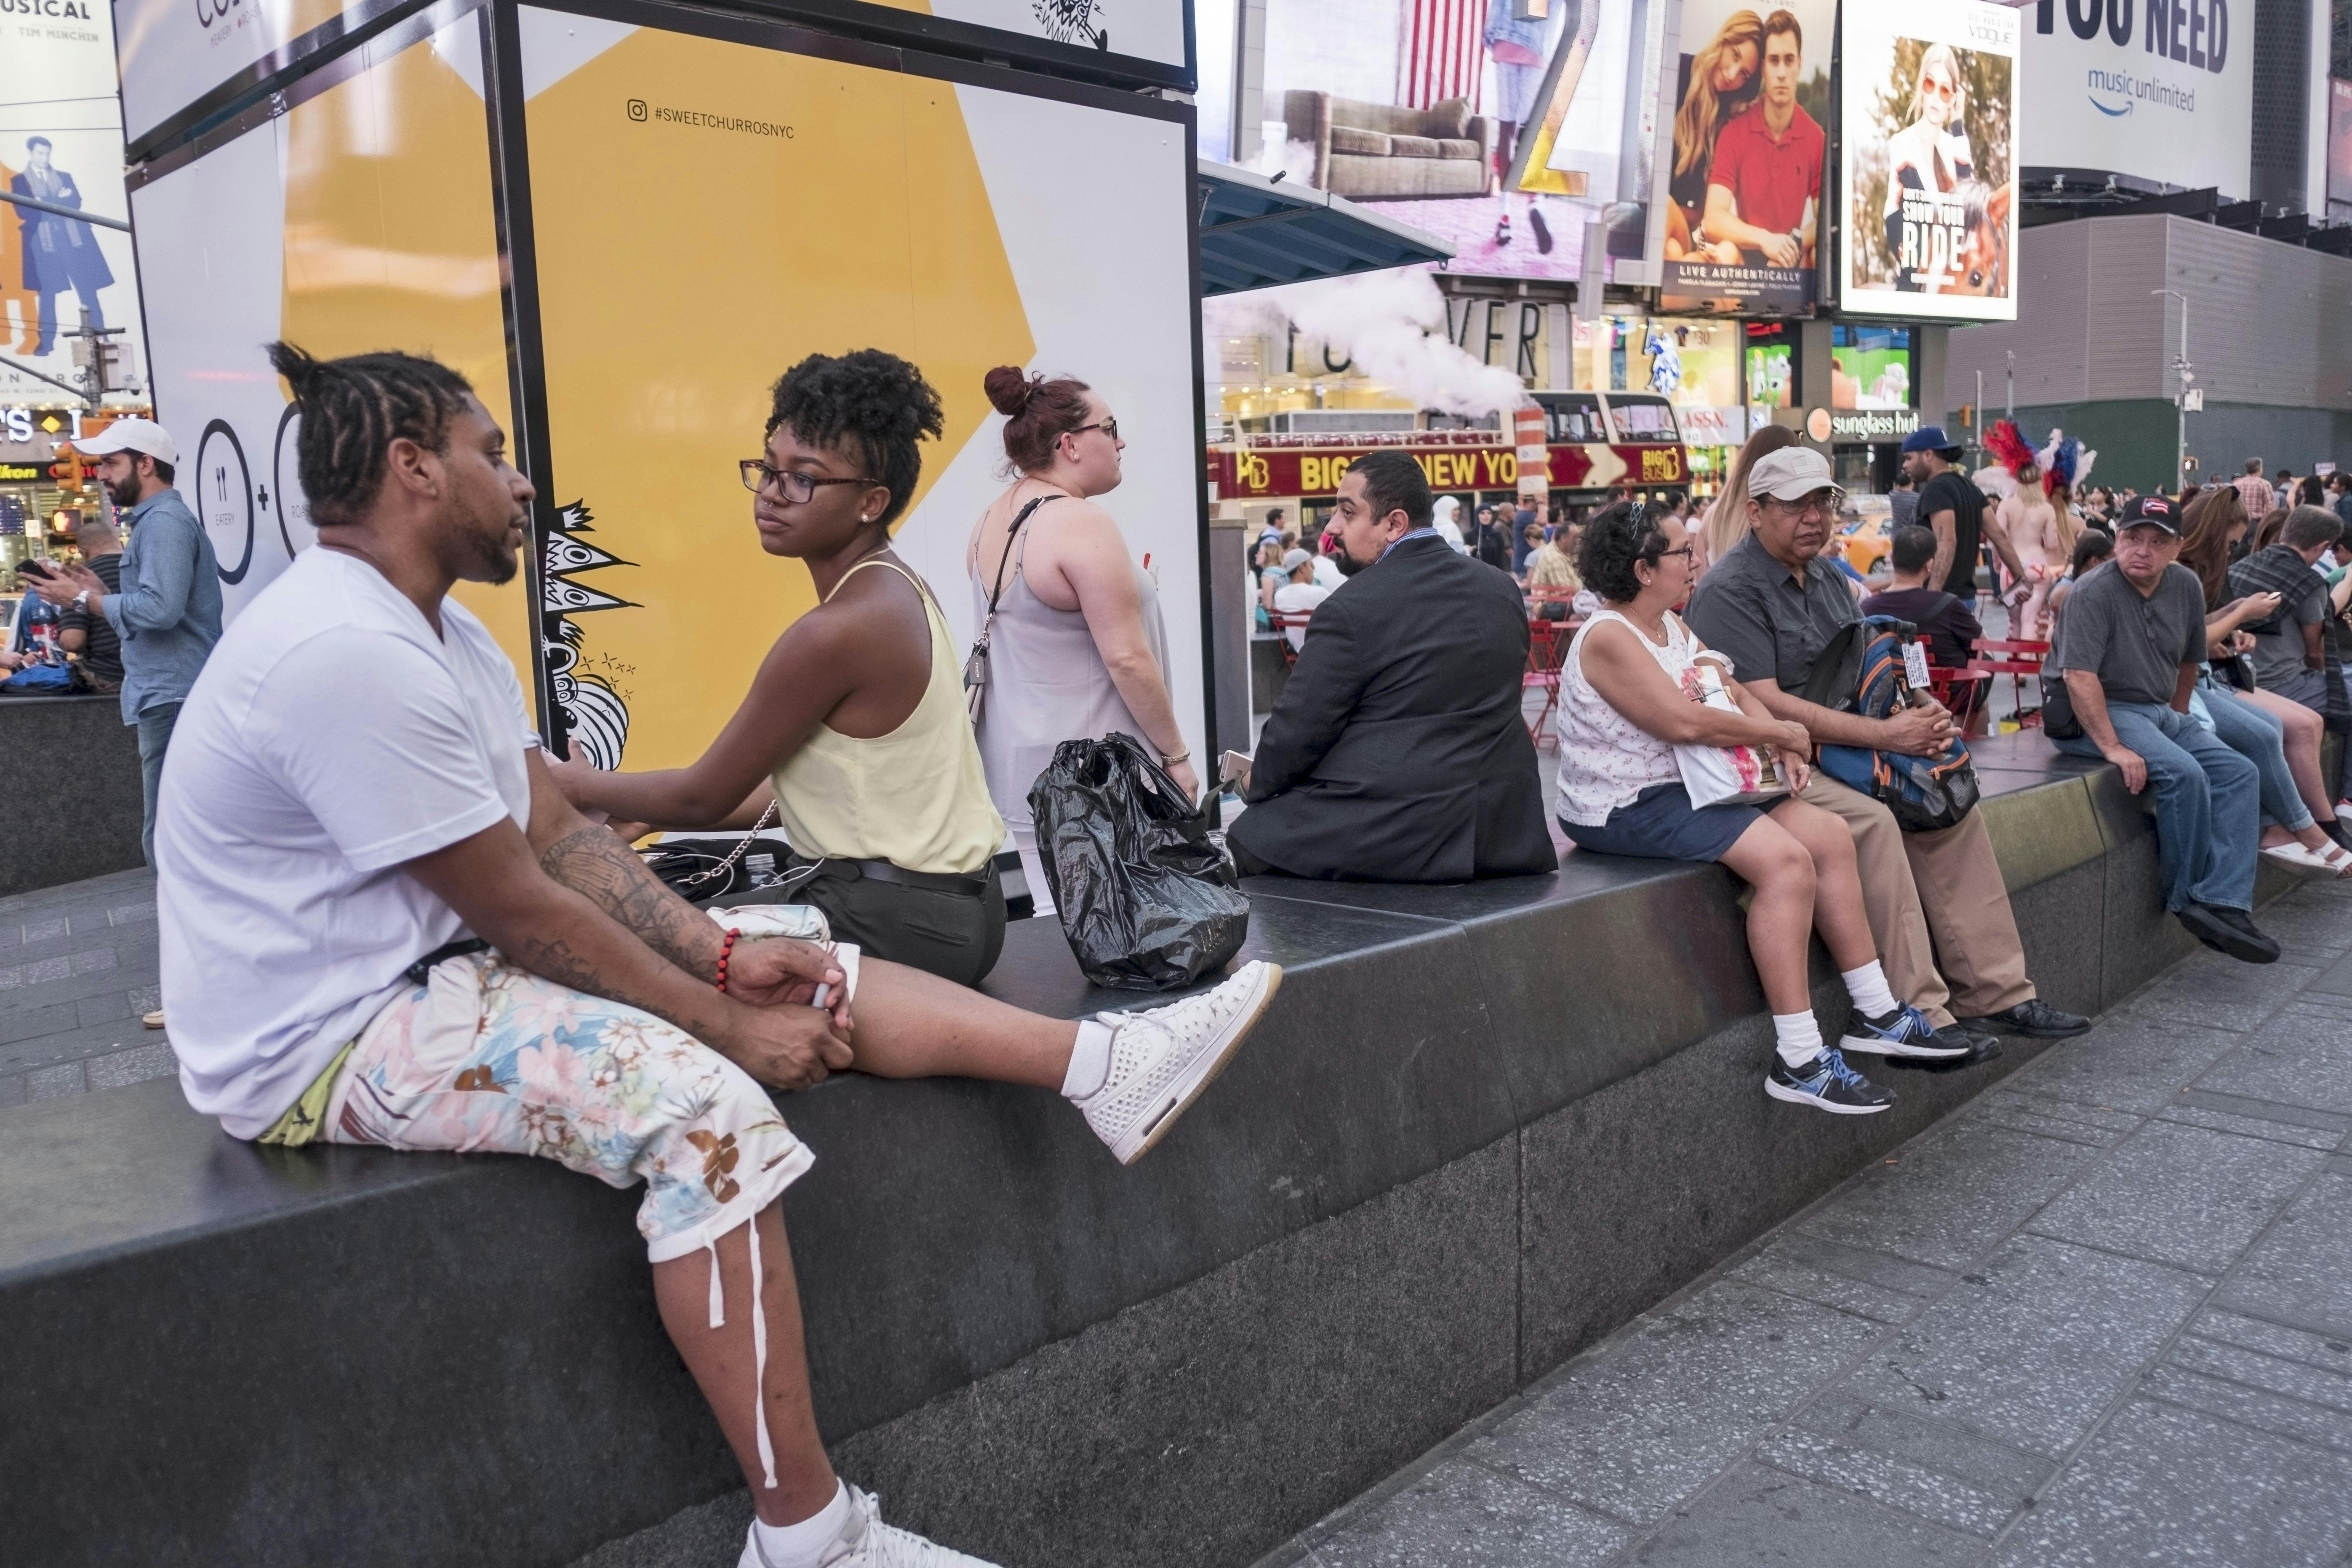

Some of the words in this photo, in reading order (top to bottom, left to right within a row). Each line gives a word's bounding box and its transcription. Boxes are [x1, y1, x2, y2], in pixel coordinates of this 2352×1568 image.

[0, 0, 90, 20] USICAL
[18, 27, 41, 37] TIM
[46, 29, 99, 42] MINCHIN
[2145, 0, 2228, 74] NEED
[2088, 69, 2133, 96] music
[2136, 76, 2194, 112] unlimited
[655, 107, 794, 139] #SWEETCHURROSNYC
[1902, 201, 1934, 224] SHOW
[1937, 203, 1965, 227] YOUR
[1902, 221, 1965, 272] RIDE
[1679, 265, 1707, 278] LIVE
[1711, 267, 1802, 282] AUTHENTICALLY
[1833, 410, 1894, 440] sunglass
[1895, 410, 1920, 434] hut
[1642, 450, 1663, 466] BIG
[0, 465, 37, 479] ikon
[1643, 466, 1664, 481] BUS
[216, 513, 234, 526] EATERY
